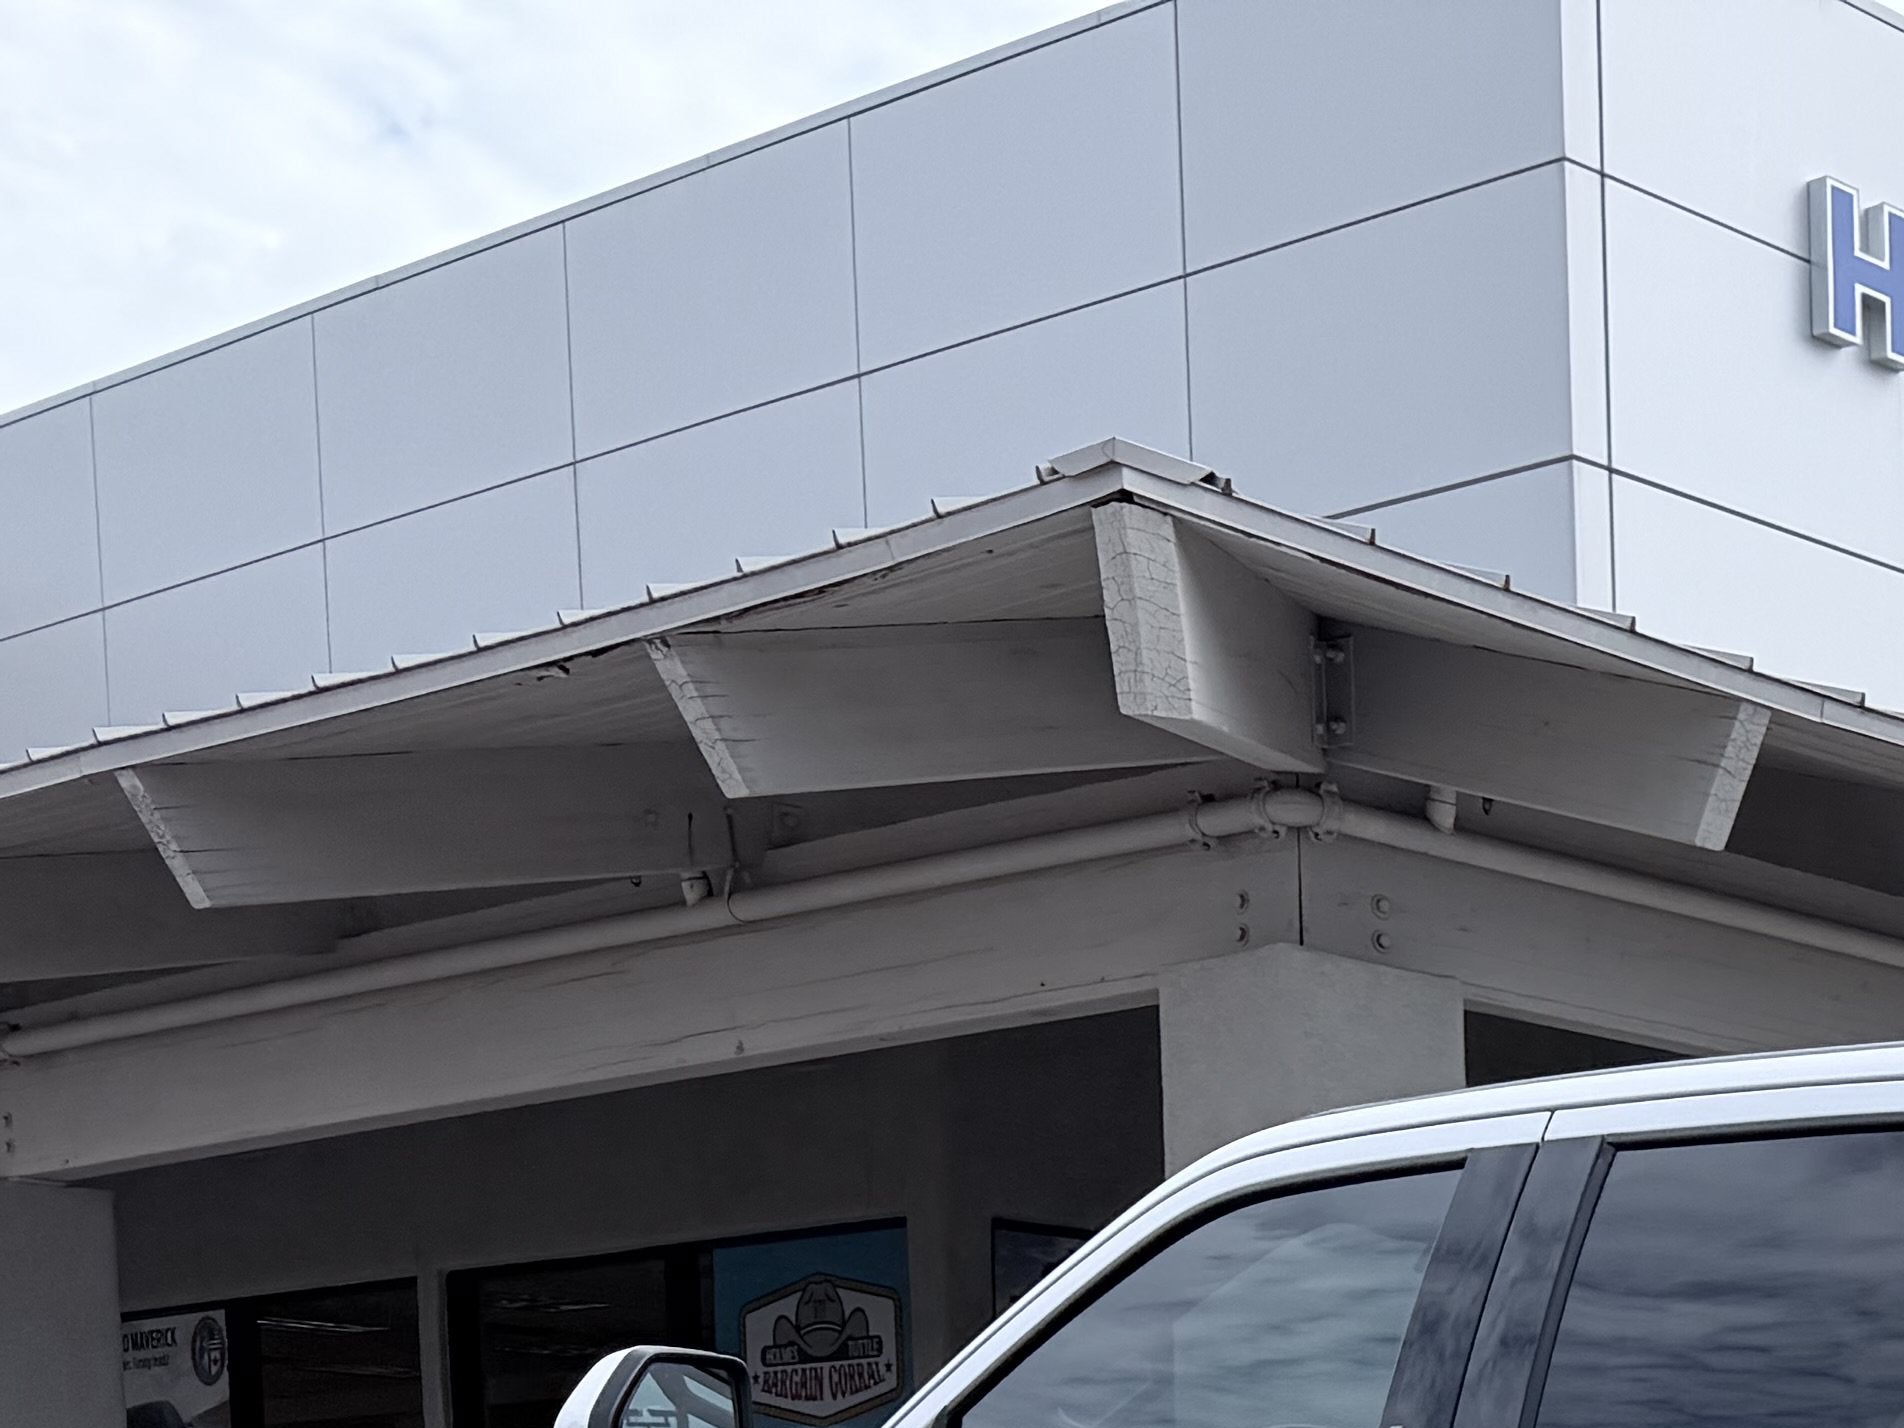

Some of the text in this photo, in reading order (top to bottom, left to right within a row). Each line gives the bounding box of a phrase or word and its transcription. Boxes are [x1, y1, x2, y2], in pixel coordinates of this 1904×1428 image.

[131, 1327, 177, 1351] MAVERICK
[848, 1337, 881, 1357] TUTTLE
[761, 1361, 885, 1401] BARGAIN CORRAL
